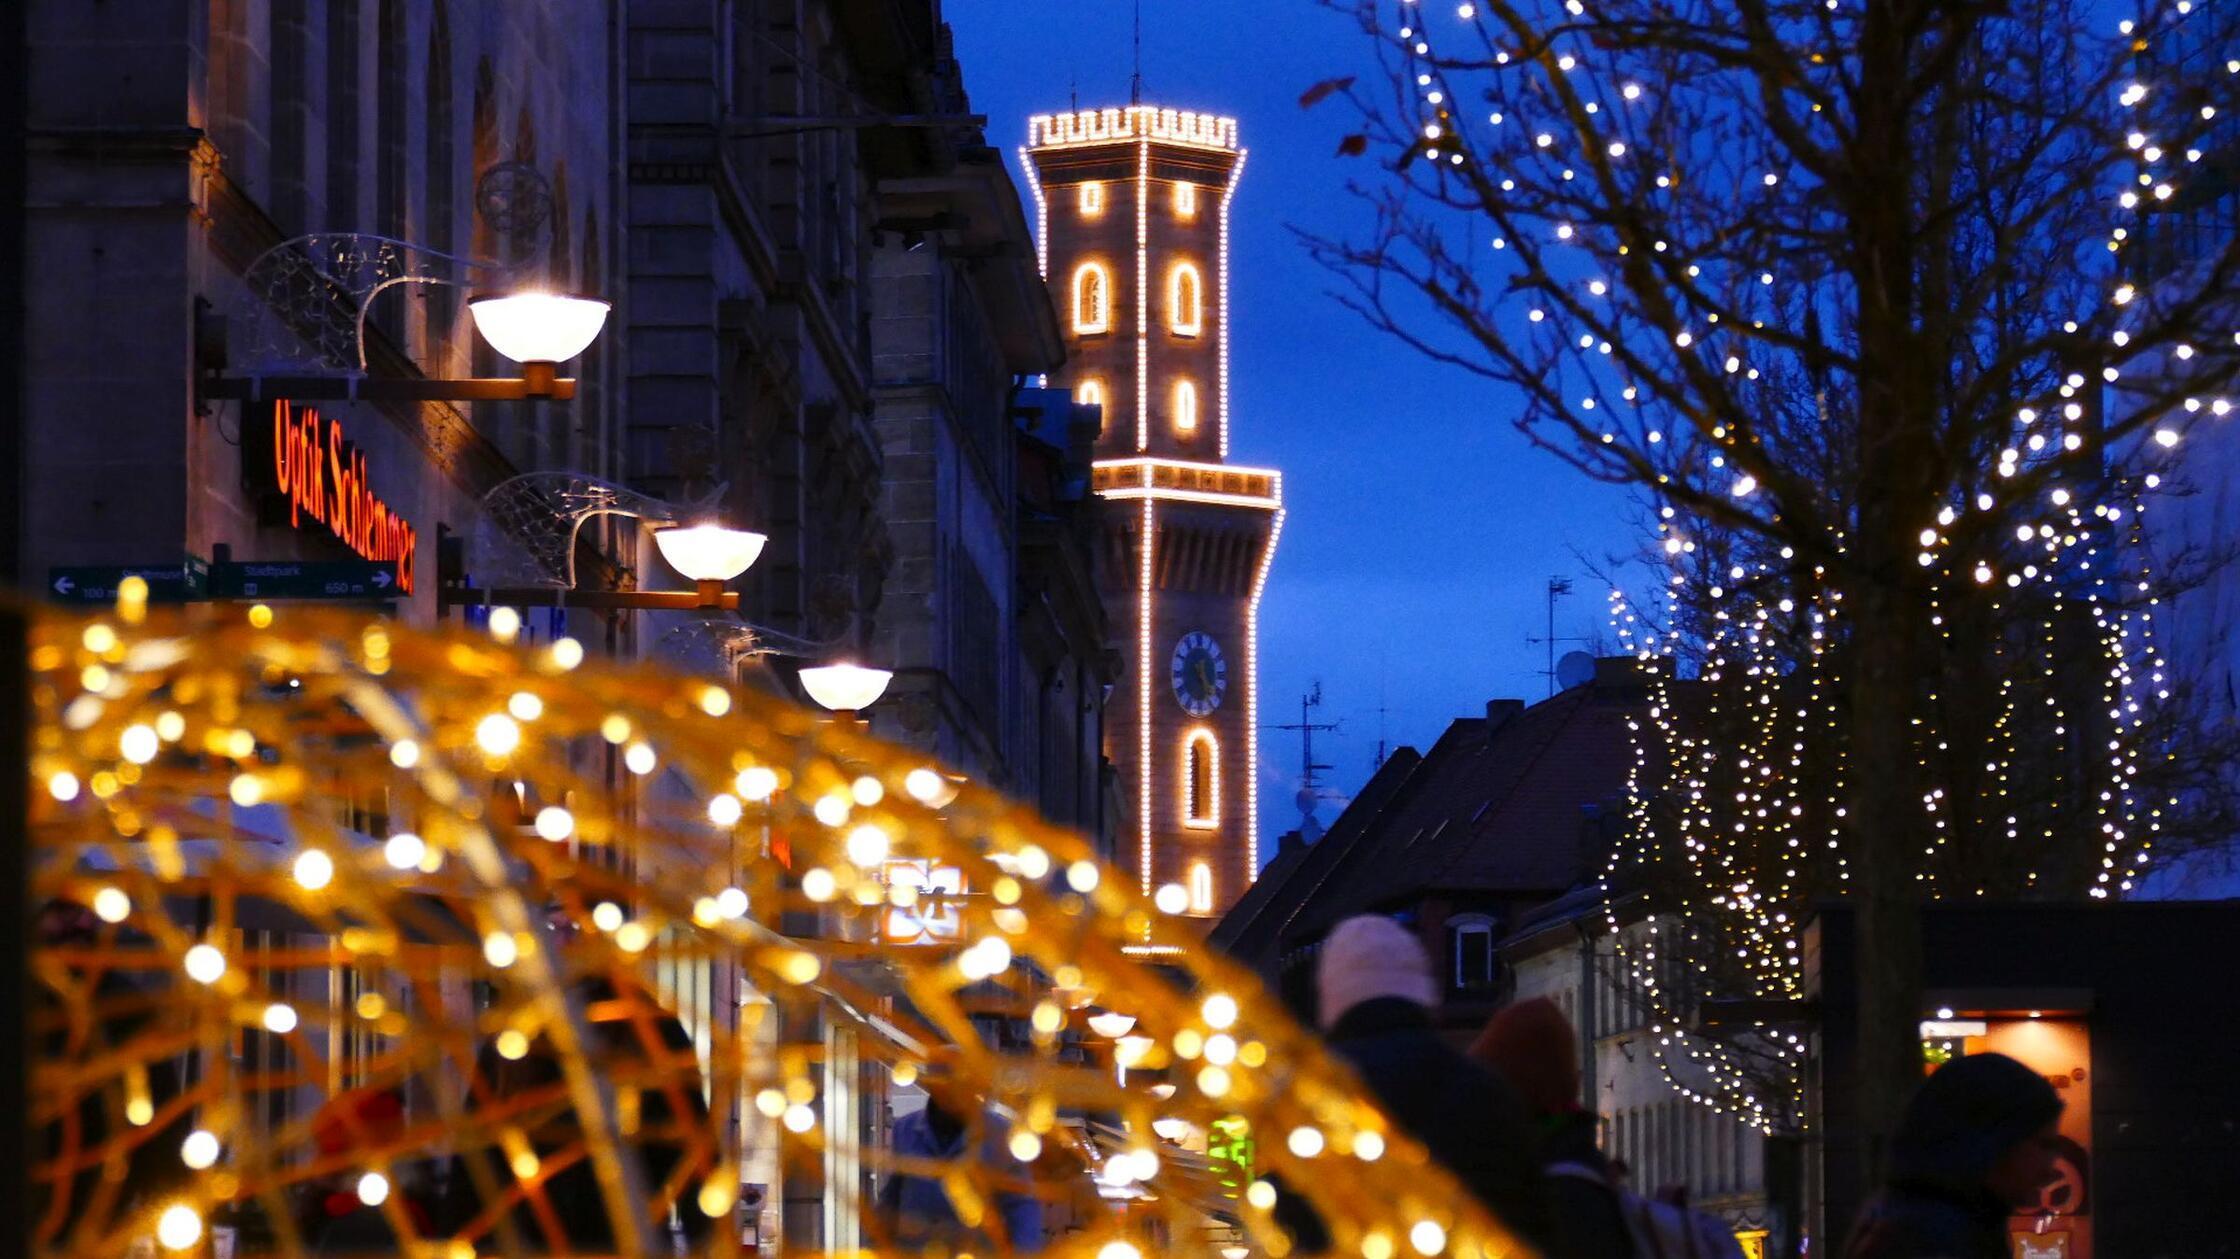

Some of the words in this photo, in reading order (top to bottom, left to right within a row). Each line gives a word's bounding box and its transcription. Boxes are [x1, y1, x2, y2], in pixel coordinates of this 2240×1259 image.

[275, 399, 324, 529] Optik
[329, 419, 416, 597] Schlemmer
[243, 565, 301, 578] Stadtpark
[83, 587, 104, 599] 100
[325, 582, 348, 594] 650
[351, 584, 364, 594] m
